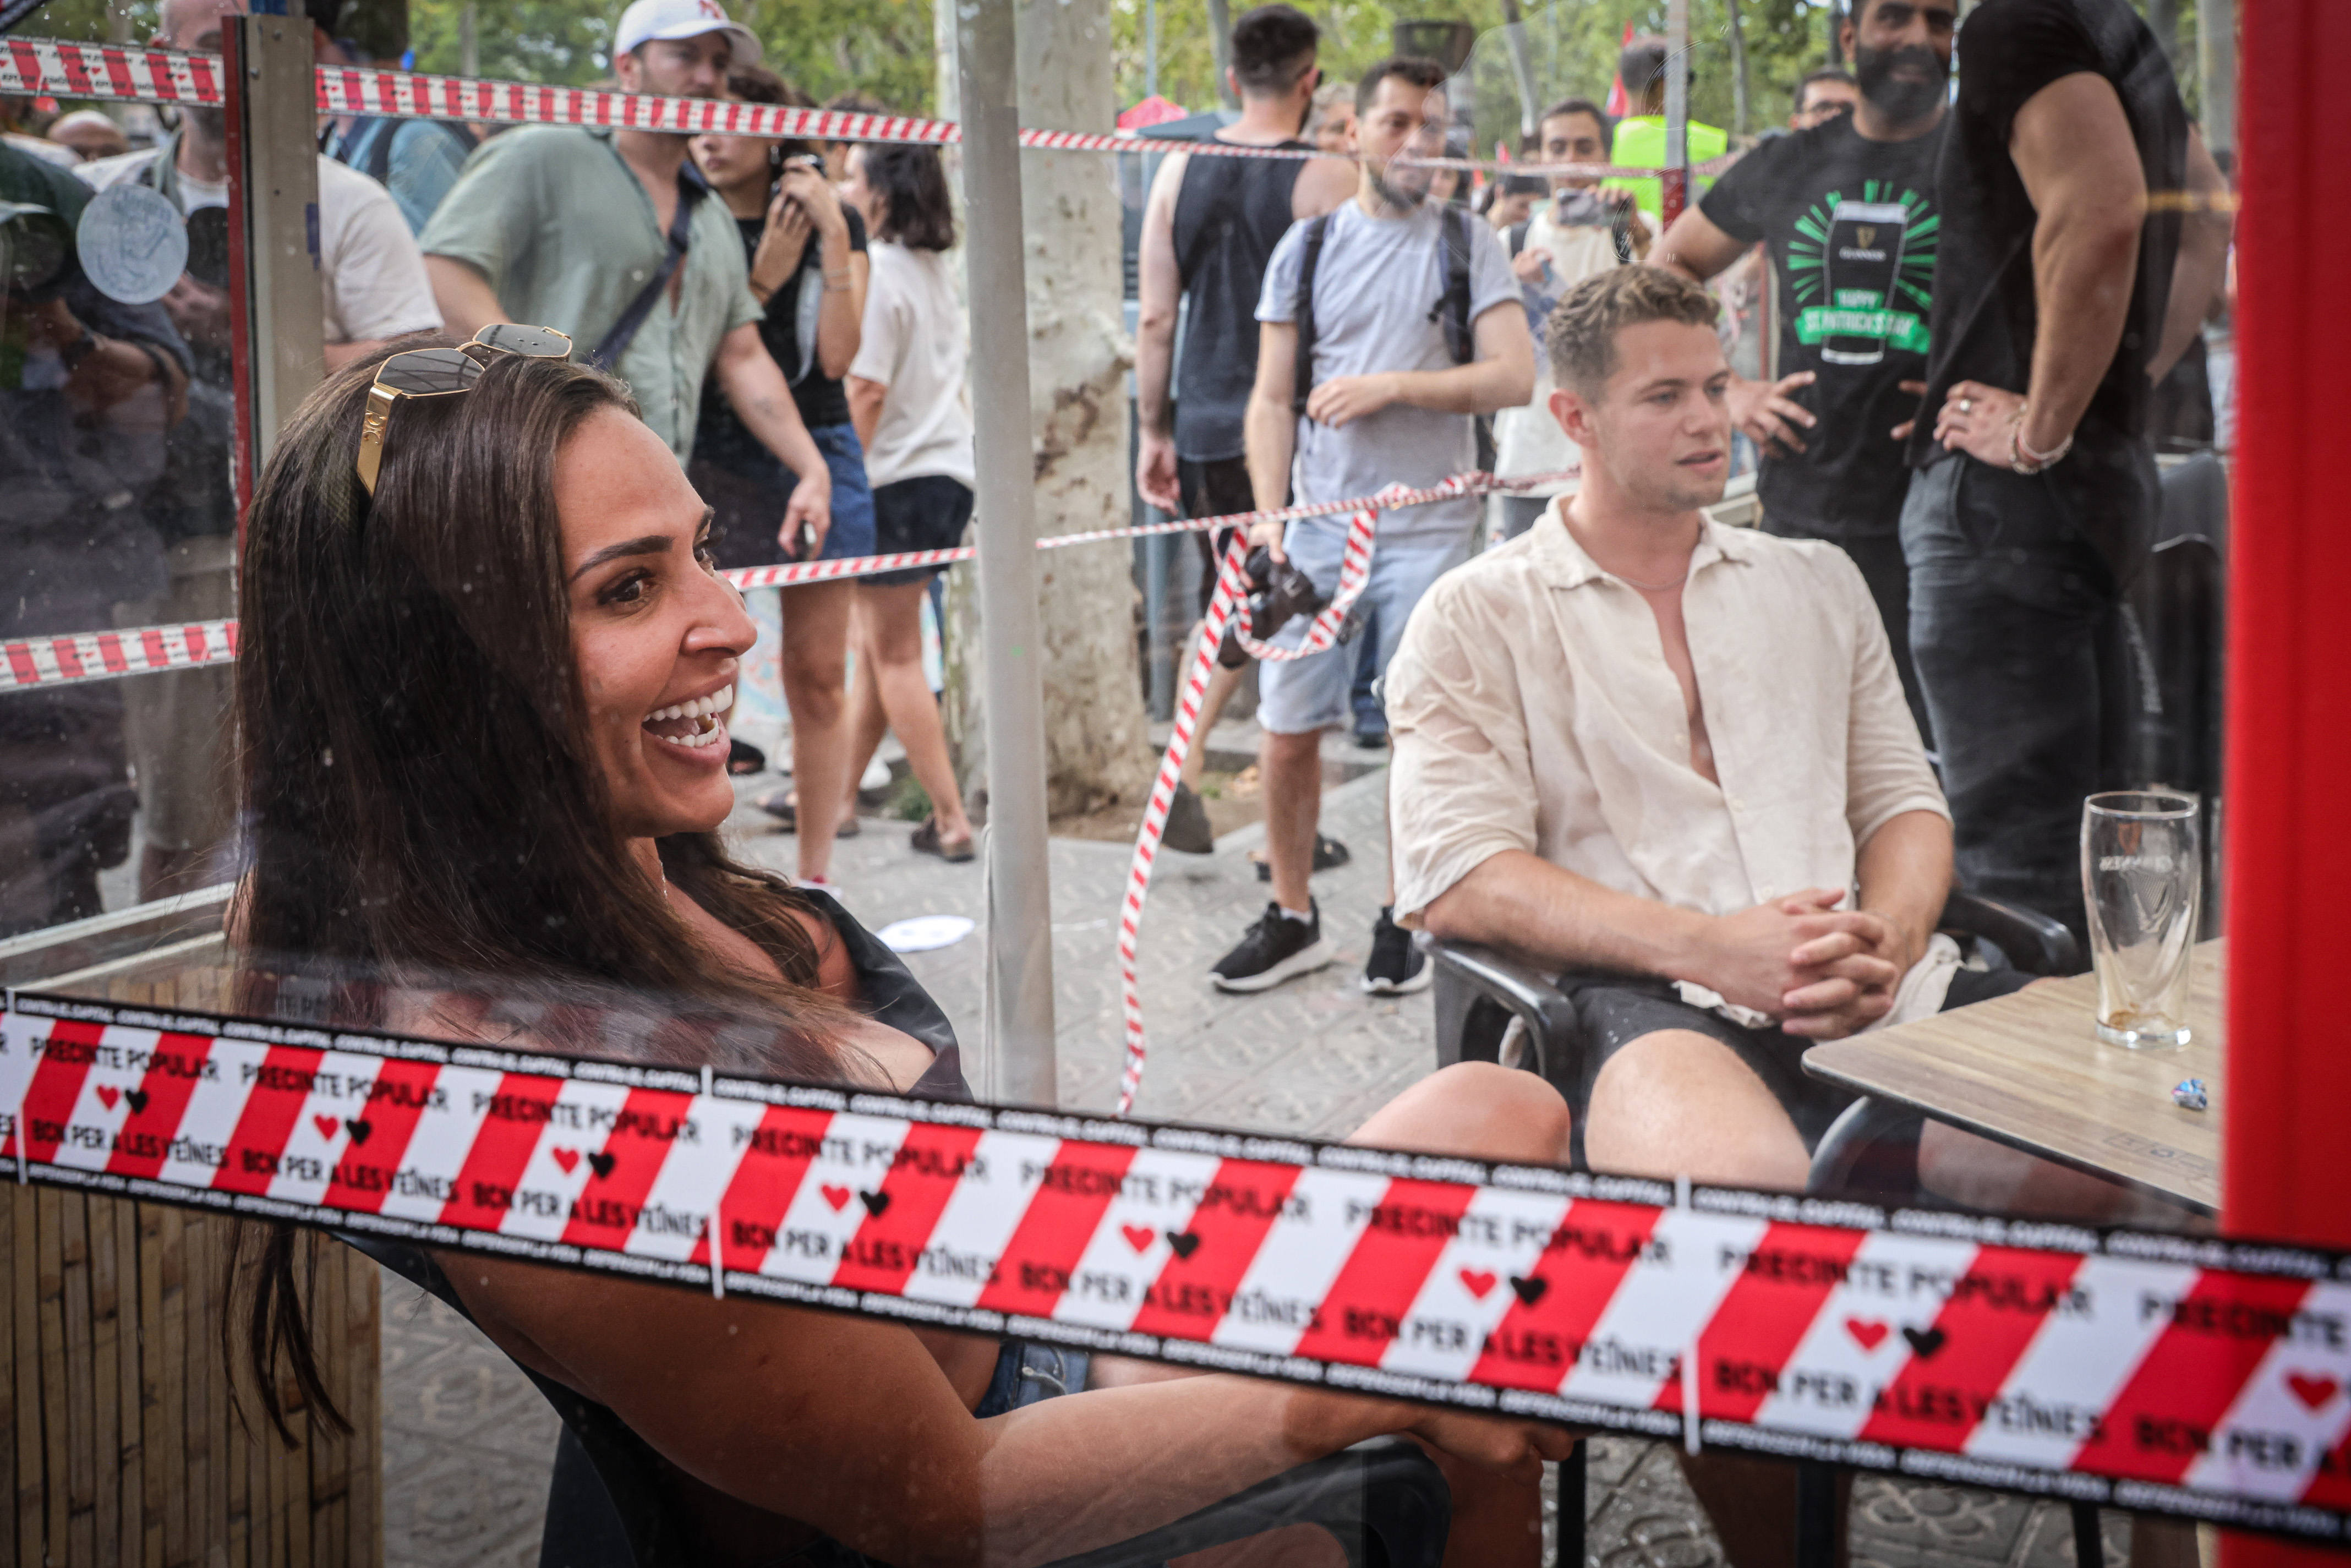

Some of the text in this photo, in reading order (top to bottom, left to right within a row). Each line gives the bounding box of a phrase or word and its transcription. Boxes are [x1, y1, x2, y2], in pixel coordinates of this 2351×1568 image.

[31, 1036, 119, 1069] PRECINTE
[128, 1048, 219, 1081] POPULAR
[242, 1064, 340, 1098] PRECINTE
[348, 1077, 449, 1112] POPULAR
[473, 1091, 582, 1129] PRECINTE
[590, 1106, 701, 1144] POPULAR
[732, 1124, 855, 1165] PRECINTE
[863, 1140, 989, 1181] POPULAR
[1021, 1159, 1160, 1203] PRECINTE
[1171, 1177, 1310, 1222] POPULAR
[1346, 1198, 1501, 1246] PRECINTE
[1515, 1219, 1671, 1267] POPULAR
[1720, 1241, 1898, 1296] PRECINTE
[1910, 1264, 2091, 1320] POPULAR
[2141, 1291, 2347, 1352] PRECINTE
[72, 1123, 103, 1151] PER
[127, 1131, 159, 1159] LES
[286, 1154, 323, 1183] PER
[345, 1162, 381, 1191] LES
[521, 1187, 560, 1218] PER
[586, 1196, 626, 1228] LES
[786, 1227, 828, 1260] PER
[858, 1237, 903, 1271] LES
[1081, 1269, 1130, 1304] PER
[1161, 1280, 1213, 1316] LES
[1413, 1315, 1468, 1353] PER
[1503, 1328, 1560, 1367] LES
[1795, 1367, 1857, 1409] PER
[1896, 1381, 1965, 1425] LES
[2227, 1428, 2302, 1474] PER
